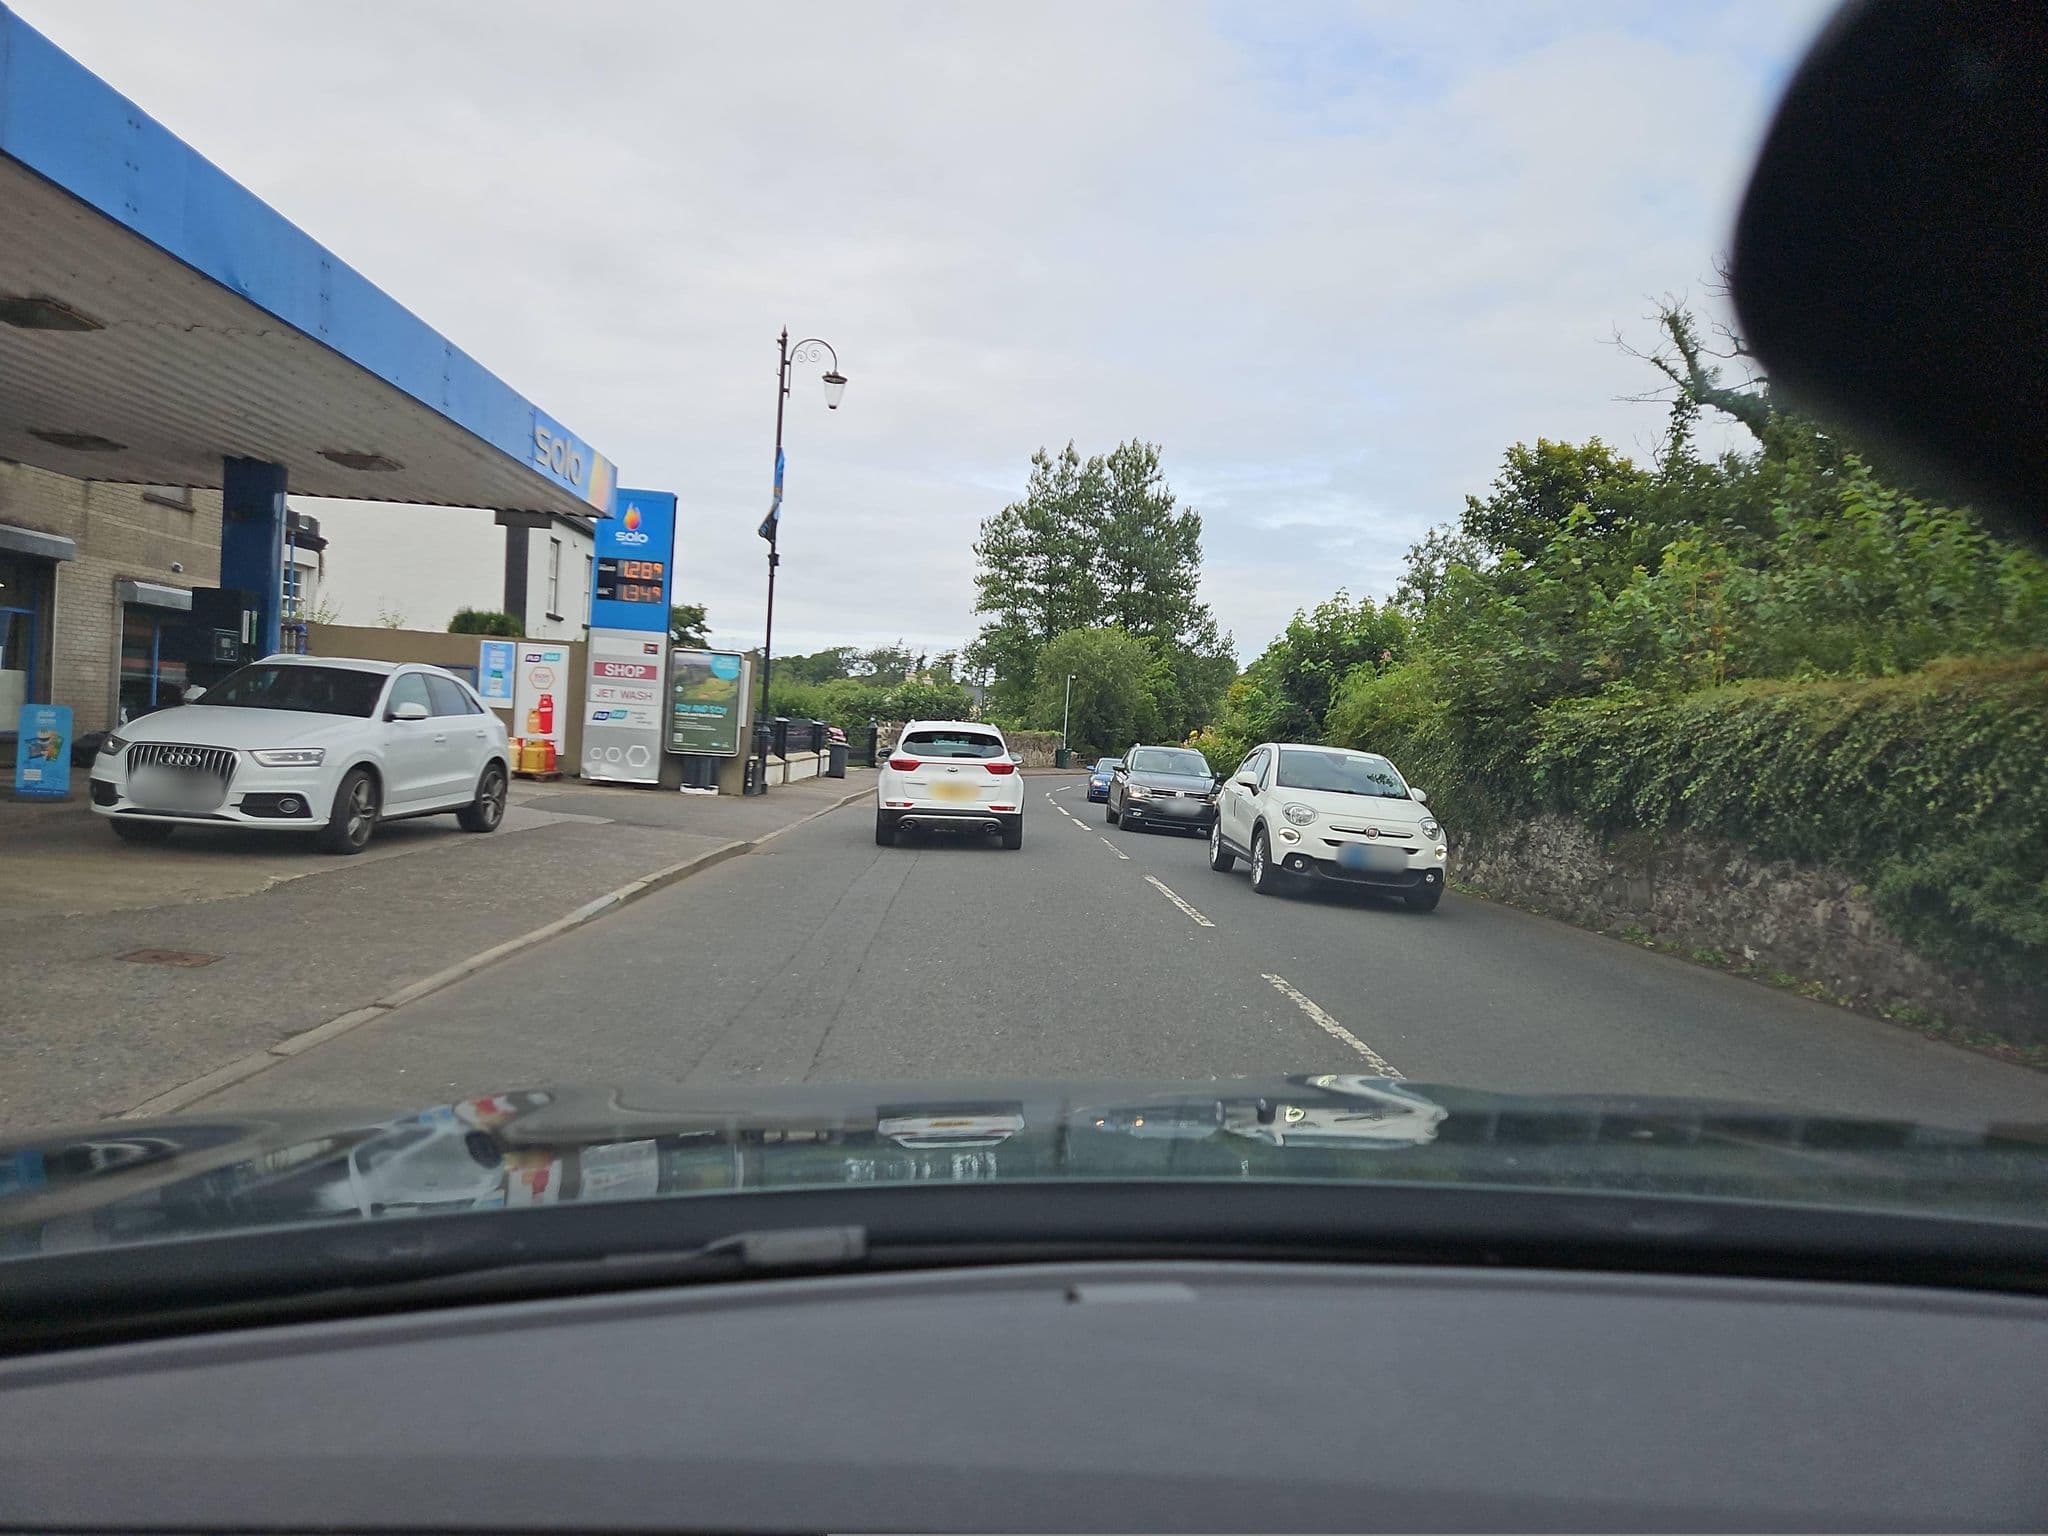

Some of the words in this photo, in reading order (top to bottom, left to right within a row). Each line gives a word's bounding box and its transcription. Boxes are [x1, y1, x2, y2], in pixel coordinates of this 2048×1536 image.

[535, 426, 582, 487] solo
[615, 531, 649, 543] solo
[604, 663, 646, 678] SHOP
[595, 688, 616, 699] JET
[620, 689, 653, 701] WASH
